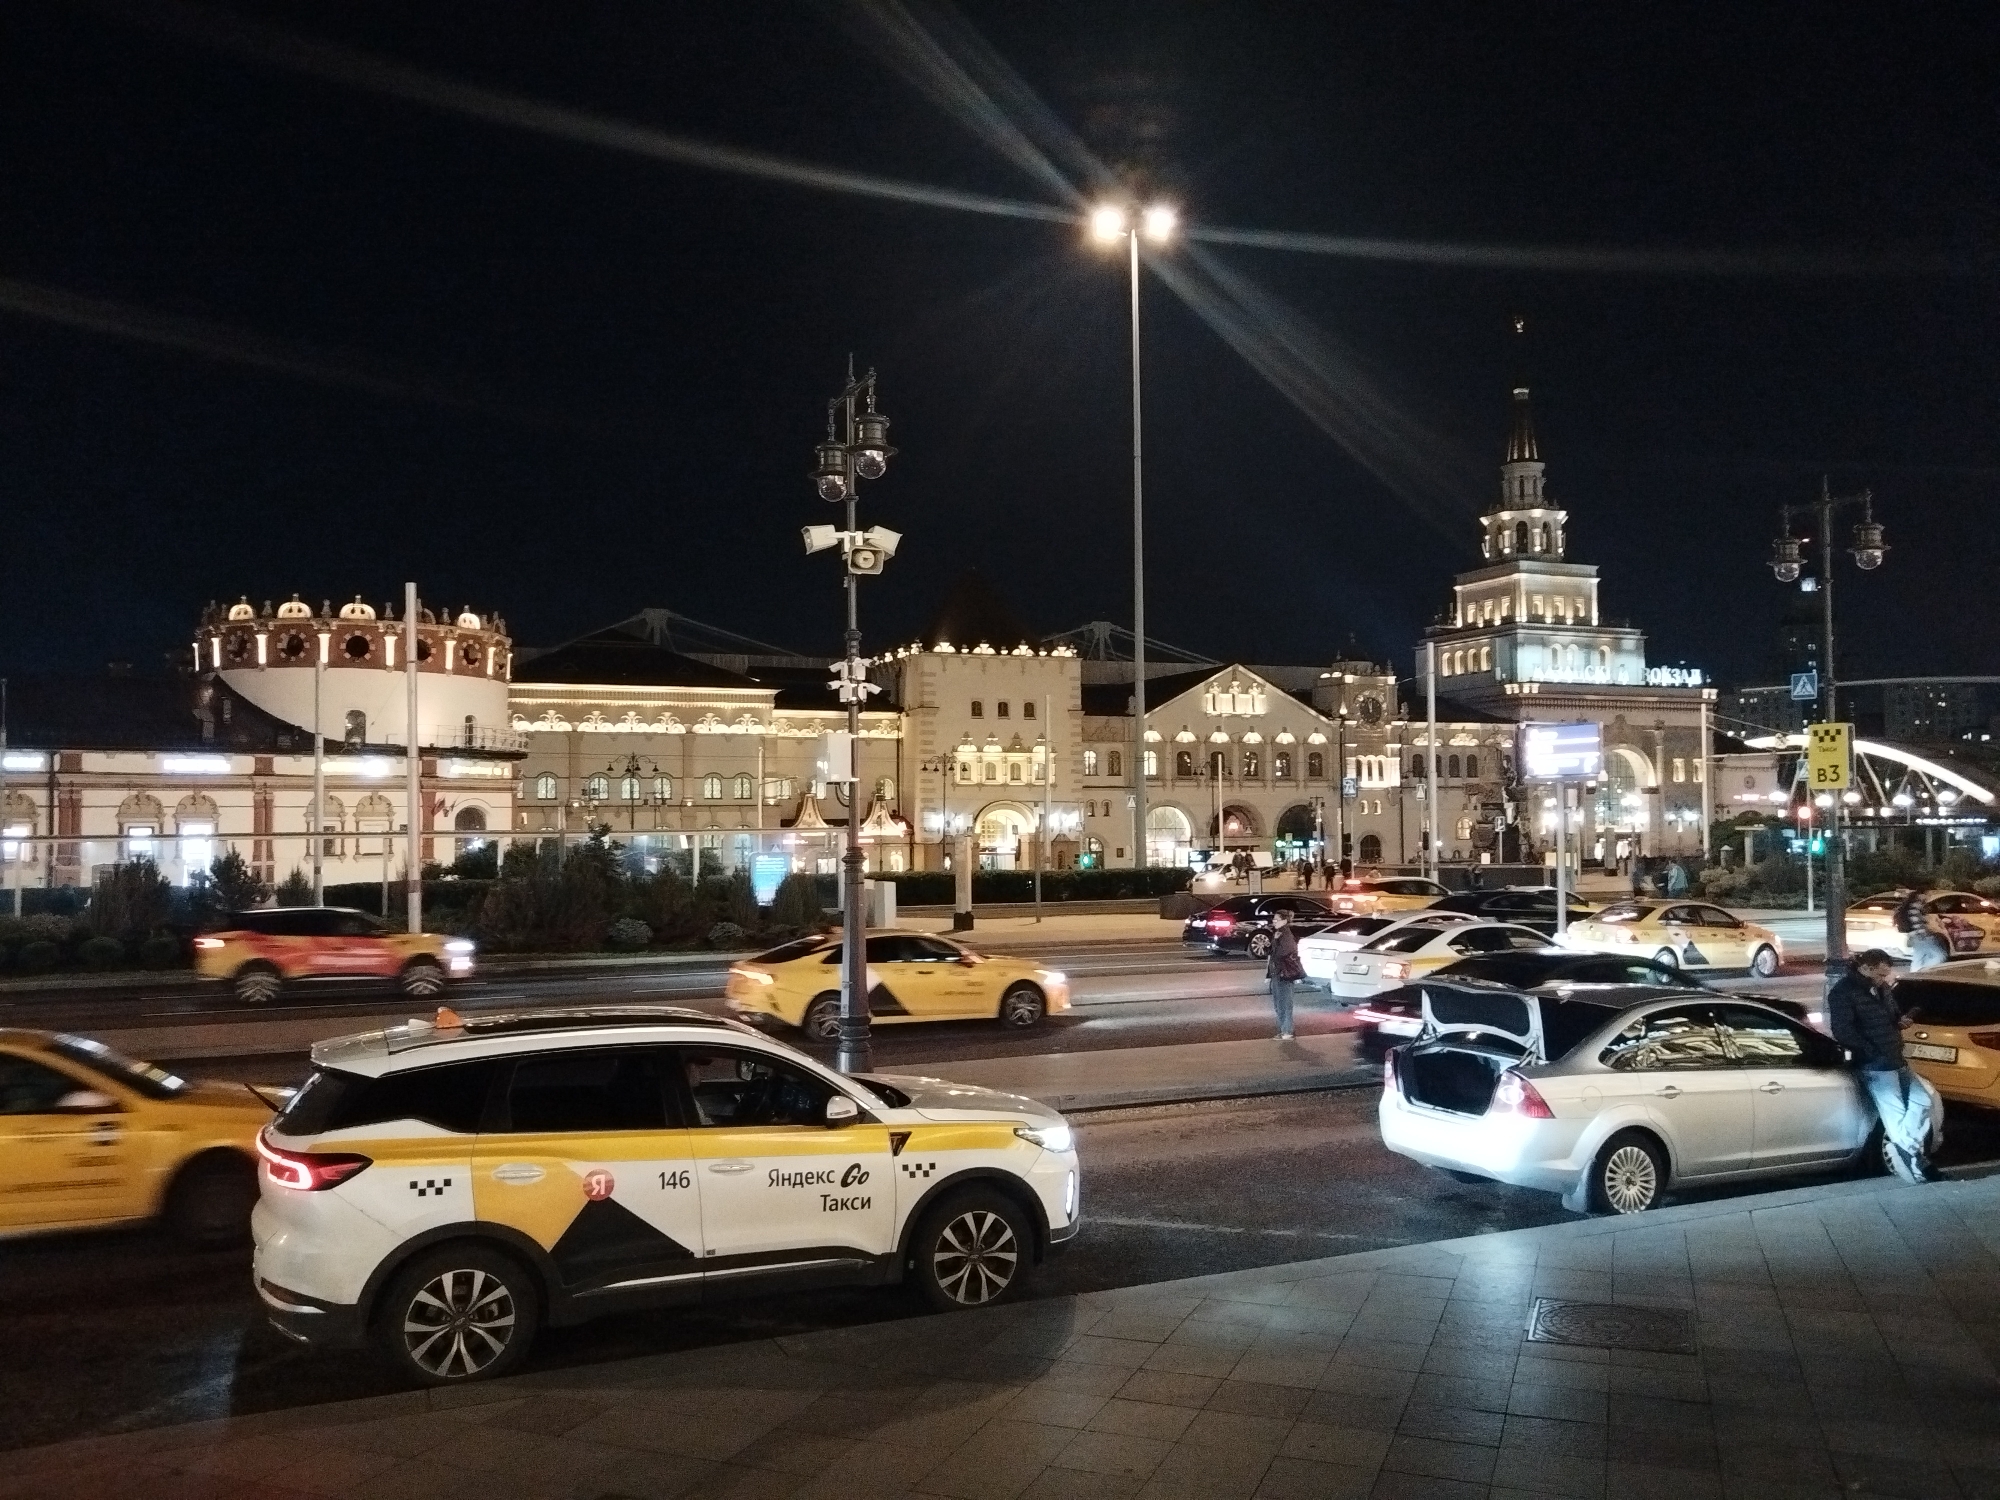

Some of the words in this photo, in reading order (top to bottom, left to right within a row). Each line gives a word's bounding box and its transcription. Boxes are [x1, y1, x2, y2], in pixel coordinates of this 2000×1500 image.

[1641, 666, 1702, 686] ВОКЗАЛ
[591, 1174, 606, 1196] Я
[658, 1169, 691, 1191] 146
[768, 1168, 836, 1189] Яндекс
[840, 1162, 870, 1188] Go
[820, 1194, 872, 1212] Такси
